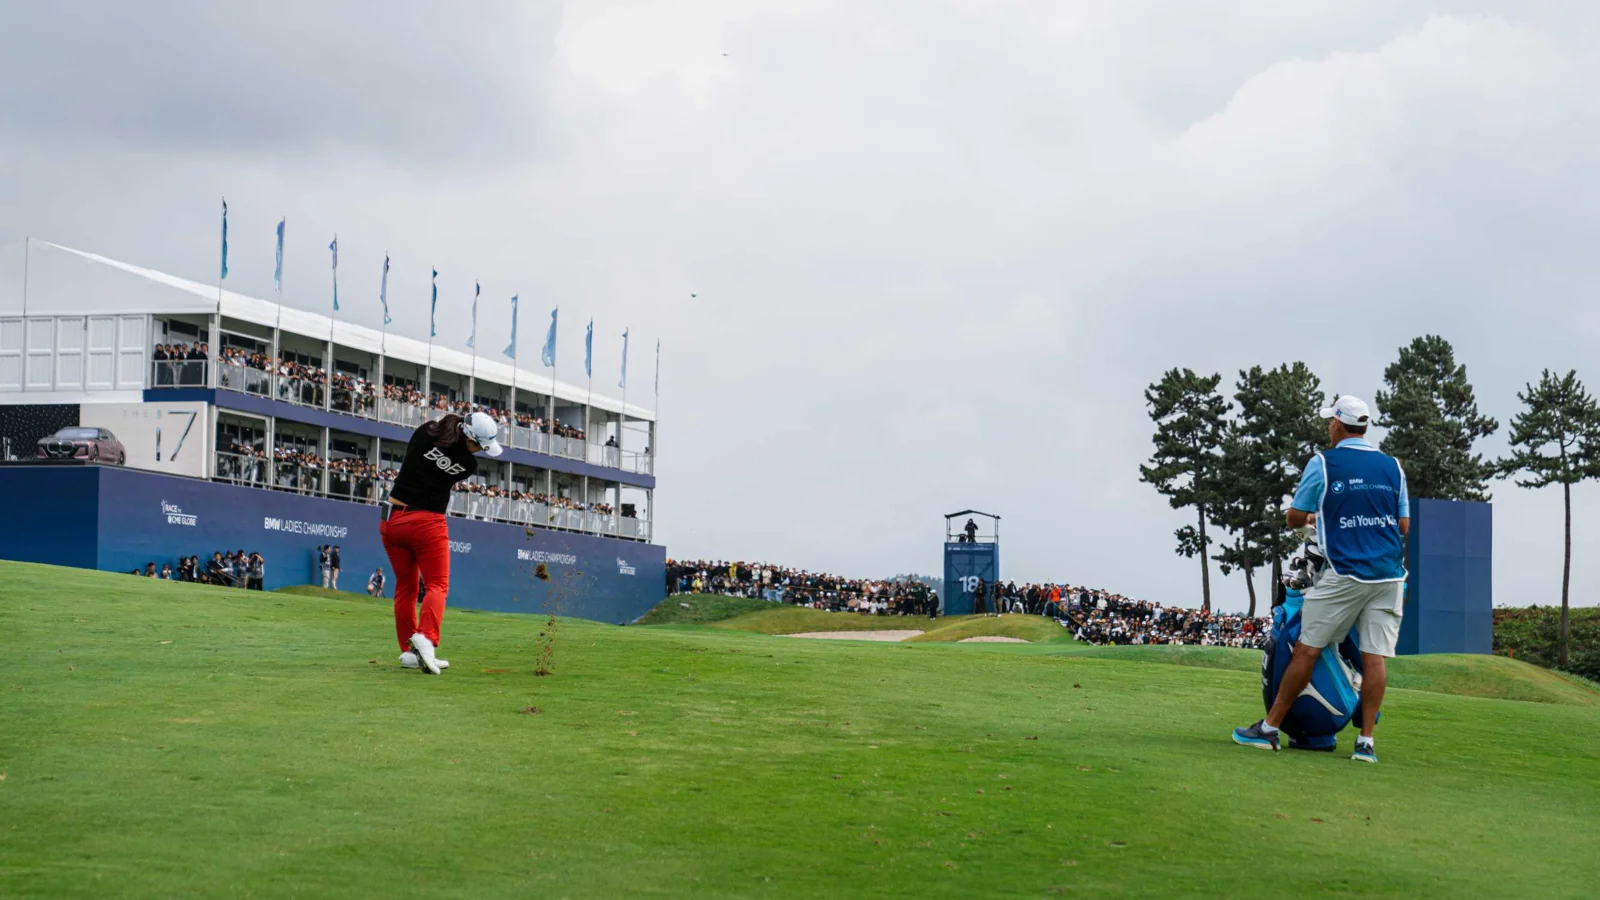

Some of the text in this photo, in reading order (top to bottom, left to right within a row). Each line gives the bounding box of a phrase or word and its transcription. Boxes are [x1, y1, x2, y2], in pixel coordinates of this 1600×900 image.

[172, 516, 196, 527] CME GLOBE
[264, 517, 347, 538] BMW LADIES CHAMPIONSHIP
[1340, 516, 1356, 528] Sei
[1357, 515, 1386, 527] Young
[448, 541, 471, 553] PIONSHIP
[959, 576, 979, 592] 18
